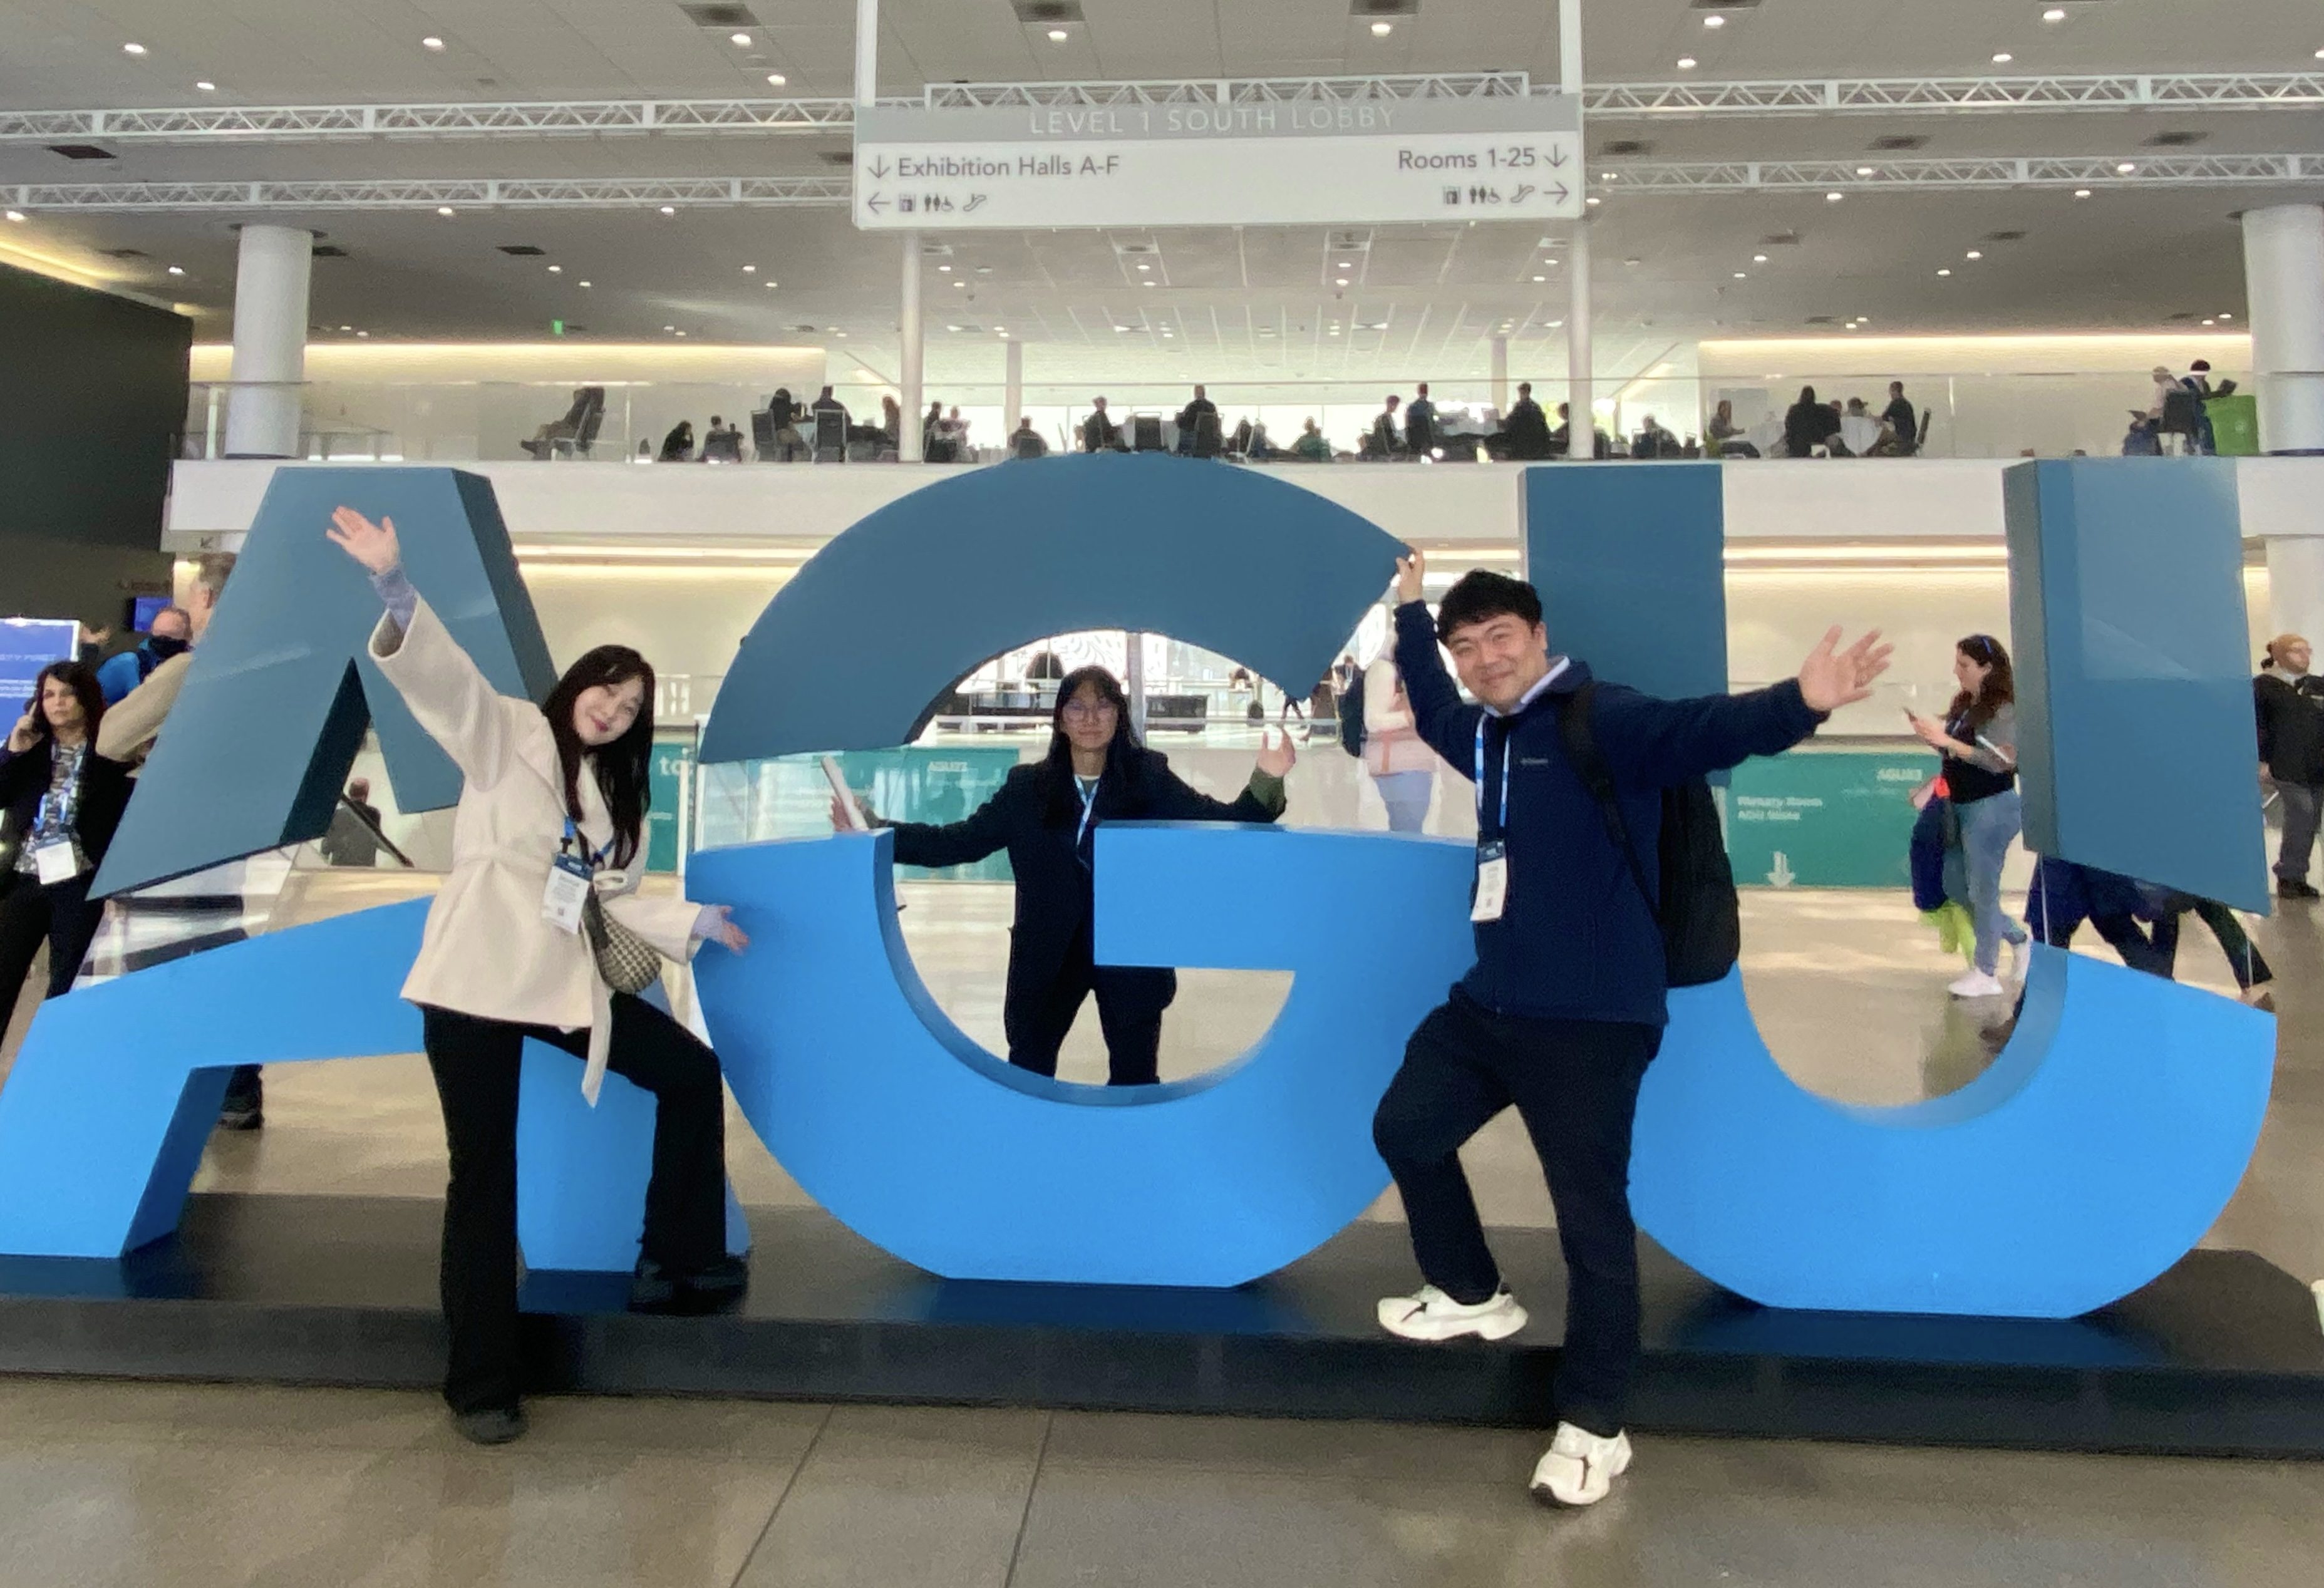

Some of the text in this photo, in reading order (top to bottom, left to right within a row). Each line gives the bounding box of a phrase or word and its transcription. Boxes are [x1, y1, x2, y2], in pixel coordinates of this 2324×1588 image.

[1030, 105, 1397, 136] LEVEL 1 SOUTH LOBBY
[898, 155, 1120, 177] Exhibition Halls A-F
[1398, 147, 1536, 170] Rooms 1-25
[0, 452, 2277, 1320] AGU
